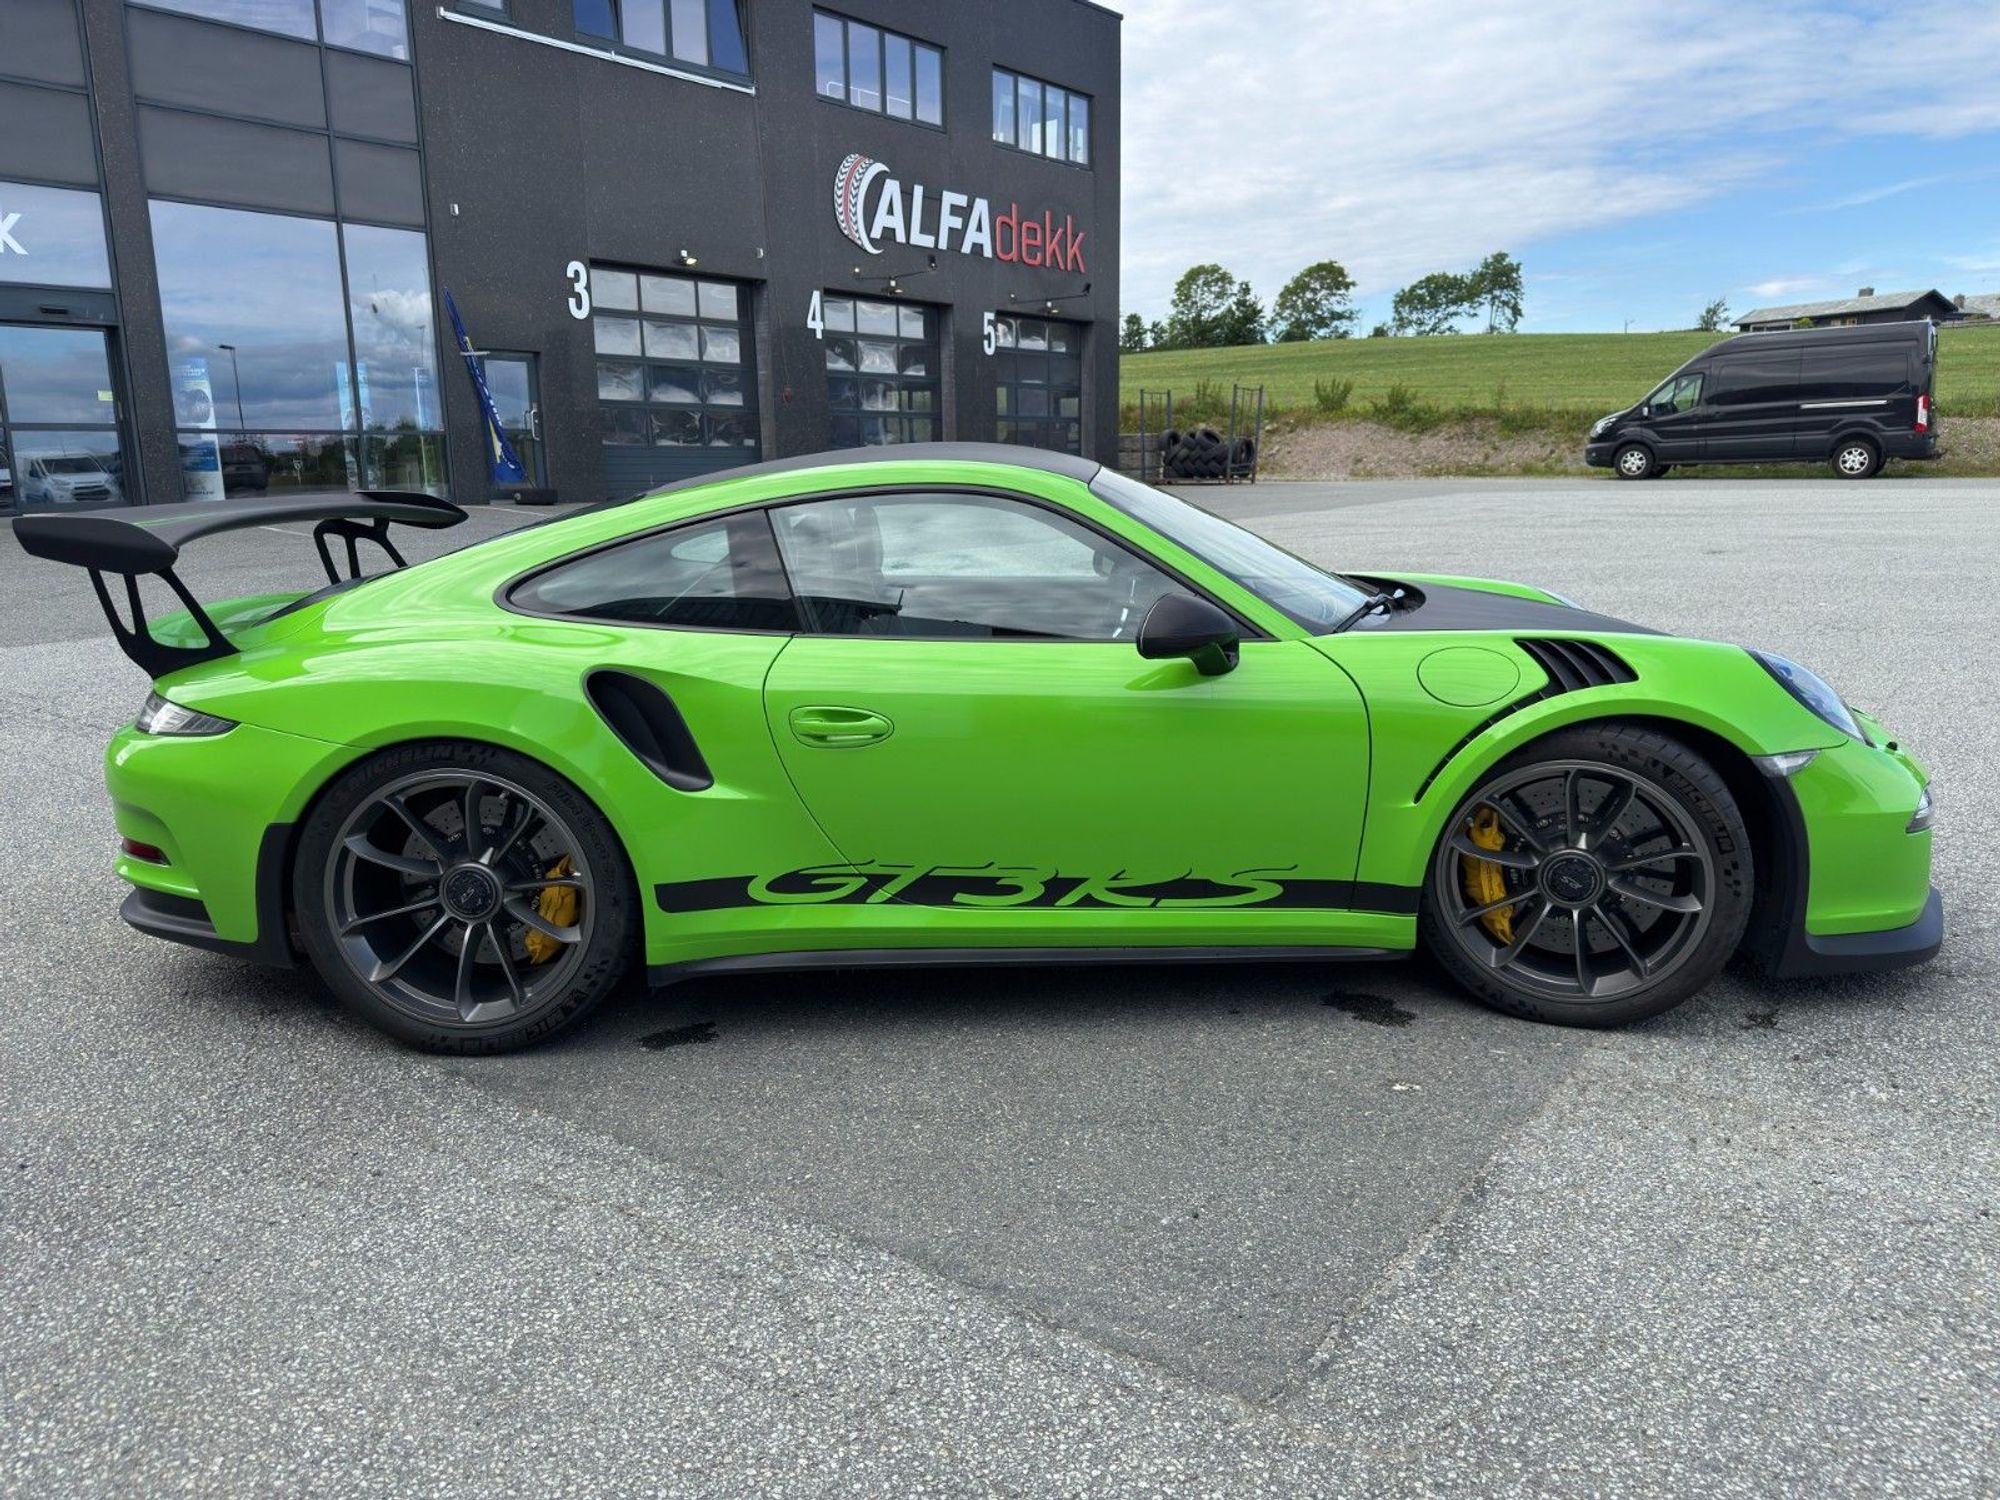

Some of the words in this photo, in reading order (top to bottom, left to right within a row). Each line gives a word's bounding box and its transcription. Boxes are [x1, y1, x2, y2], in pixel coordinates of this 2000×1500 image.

[566, 260, 590, 320] 3
[807, 290, 824, 340] 4
[983, 311, 996, 356] 5
